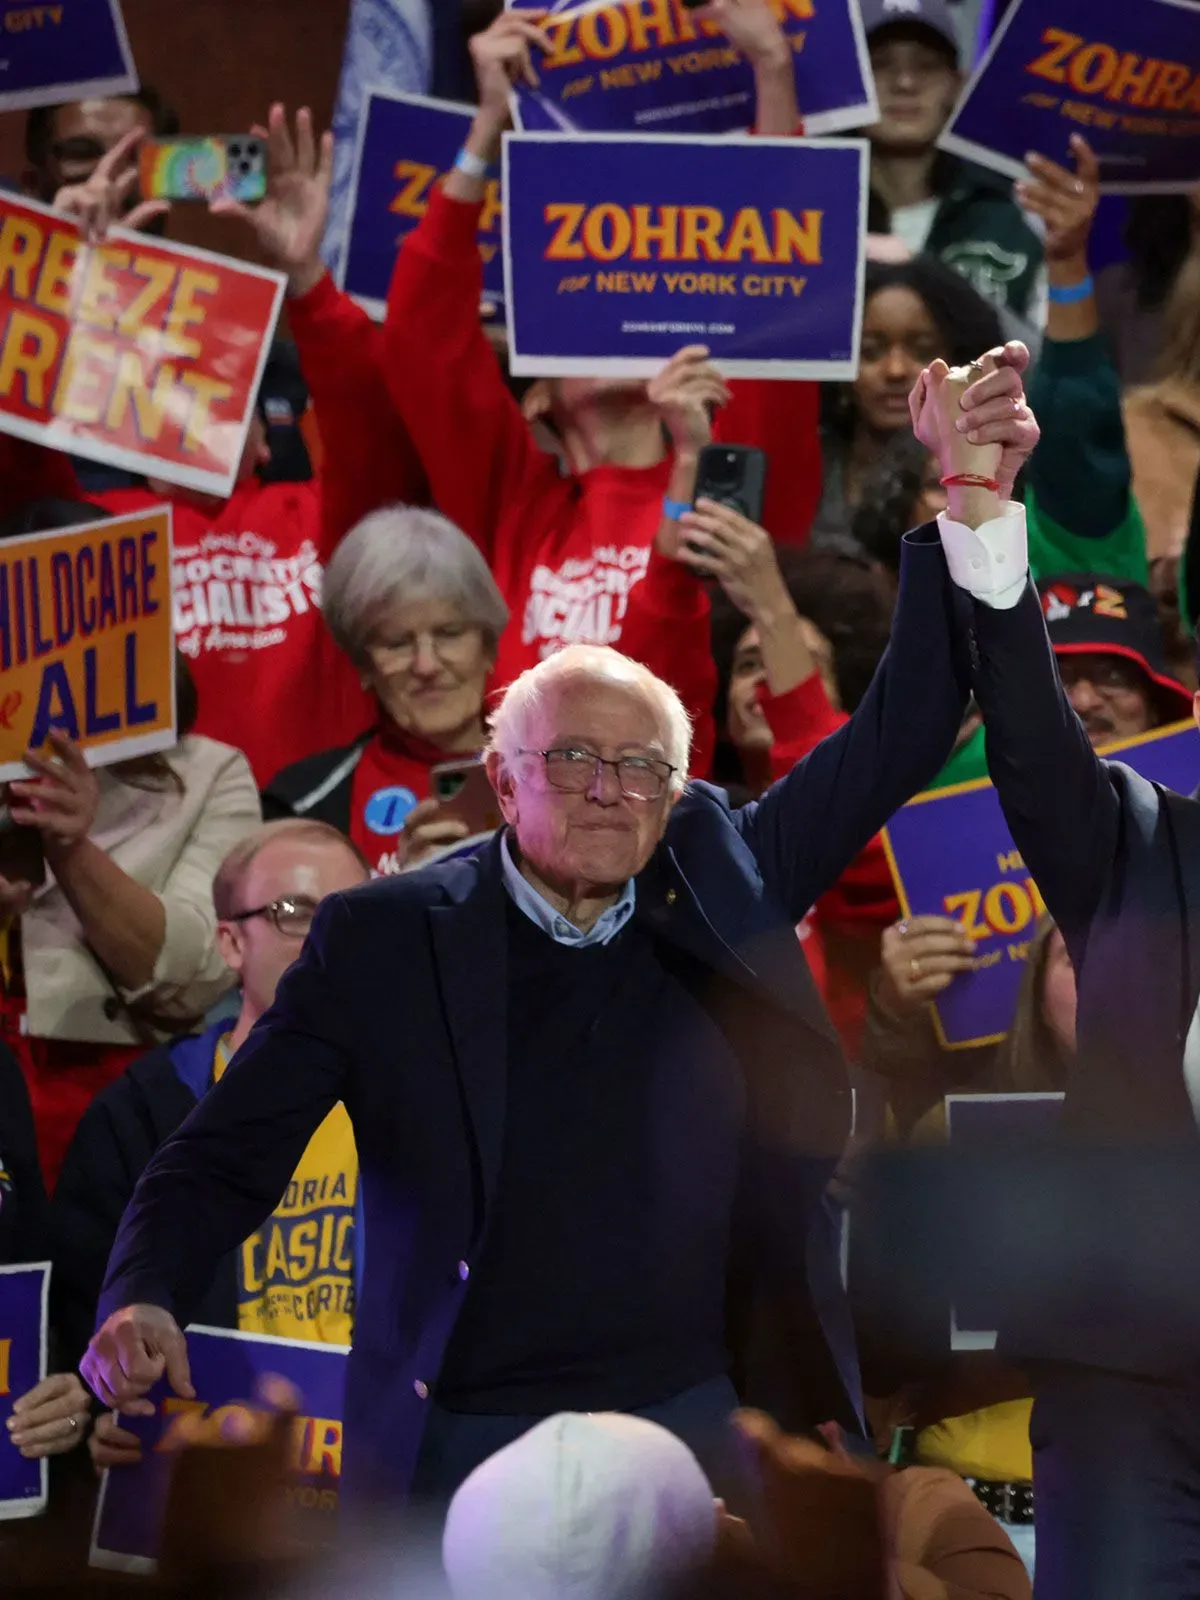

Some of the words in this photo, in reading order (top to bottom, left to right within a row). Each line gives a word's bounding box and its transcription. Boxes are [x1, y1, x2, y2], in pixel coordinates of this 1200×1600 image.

[602, 58, 662, 90] NEW
[666, 48, 742, 76] YORK
[544, 202, 825, 265] ZOHRAN
[0, 213, 220, 361] REEZE
[556, 273, 592, 296] for
[595, 269, 658, 294] NEW
[661, 271, 738, 296] YORK
[741, 274, 809, 298] CITY
[0, 307, 236, 454] RENT
[29, 629, 159, 749] ALL
